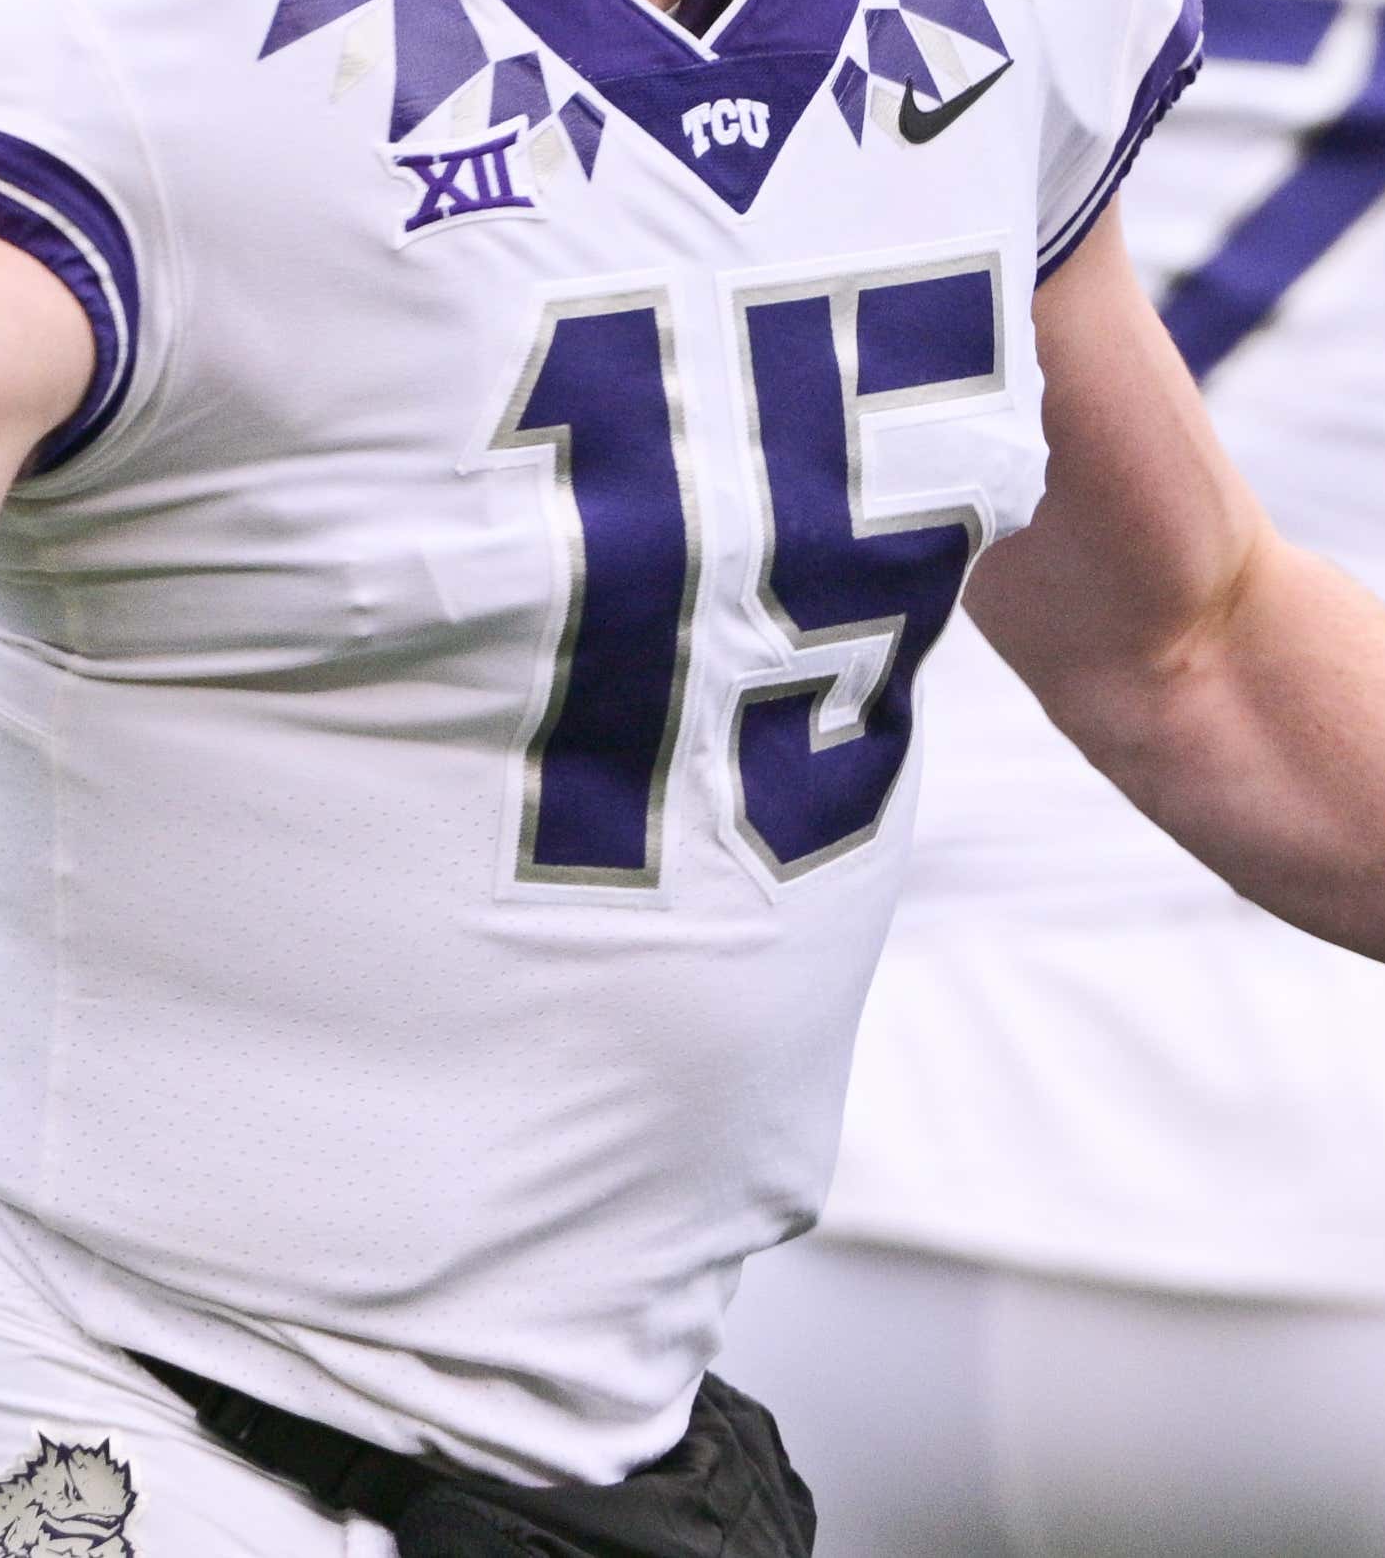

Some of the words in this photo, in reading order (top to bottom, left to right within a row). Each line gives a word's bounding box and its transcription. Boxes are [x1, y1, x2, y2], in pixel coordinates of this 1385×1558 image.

[393, 128, 536, 234] XII
[681, 98, 770, 160] TCU
[483, 250, 1011, 892] 15
